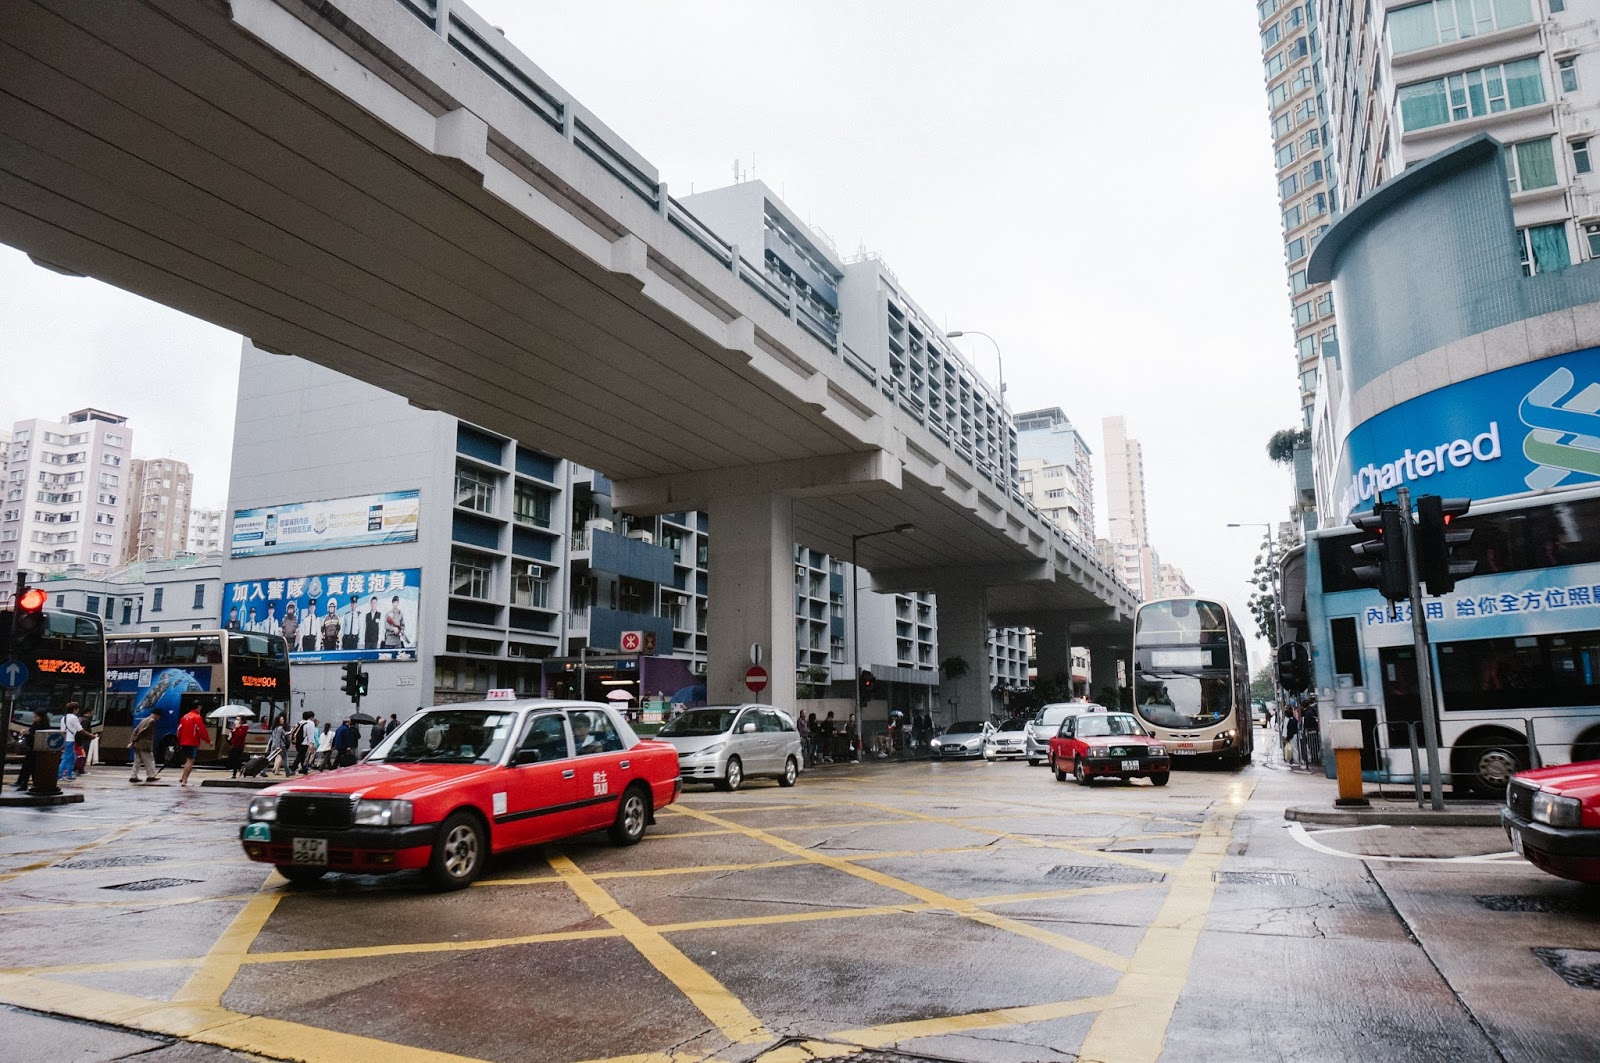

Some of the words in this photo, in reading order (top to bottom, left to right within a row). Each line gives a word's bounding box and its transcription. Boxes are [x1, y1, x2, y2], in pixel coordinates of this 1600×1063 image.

[1358, 421, 1501, 500] Chartered
[232, 579, 303, 602] 加入警隊
[327, 571, 406, 596] 實踐抱負
[262, 676, 277, 688] 904
[592, 770, 608, 783] 的士
[592, 782, 608, 796] TAXI
